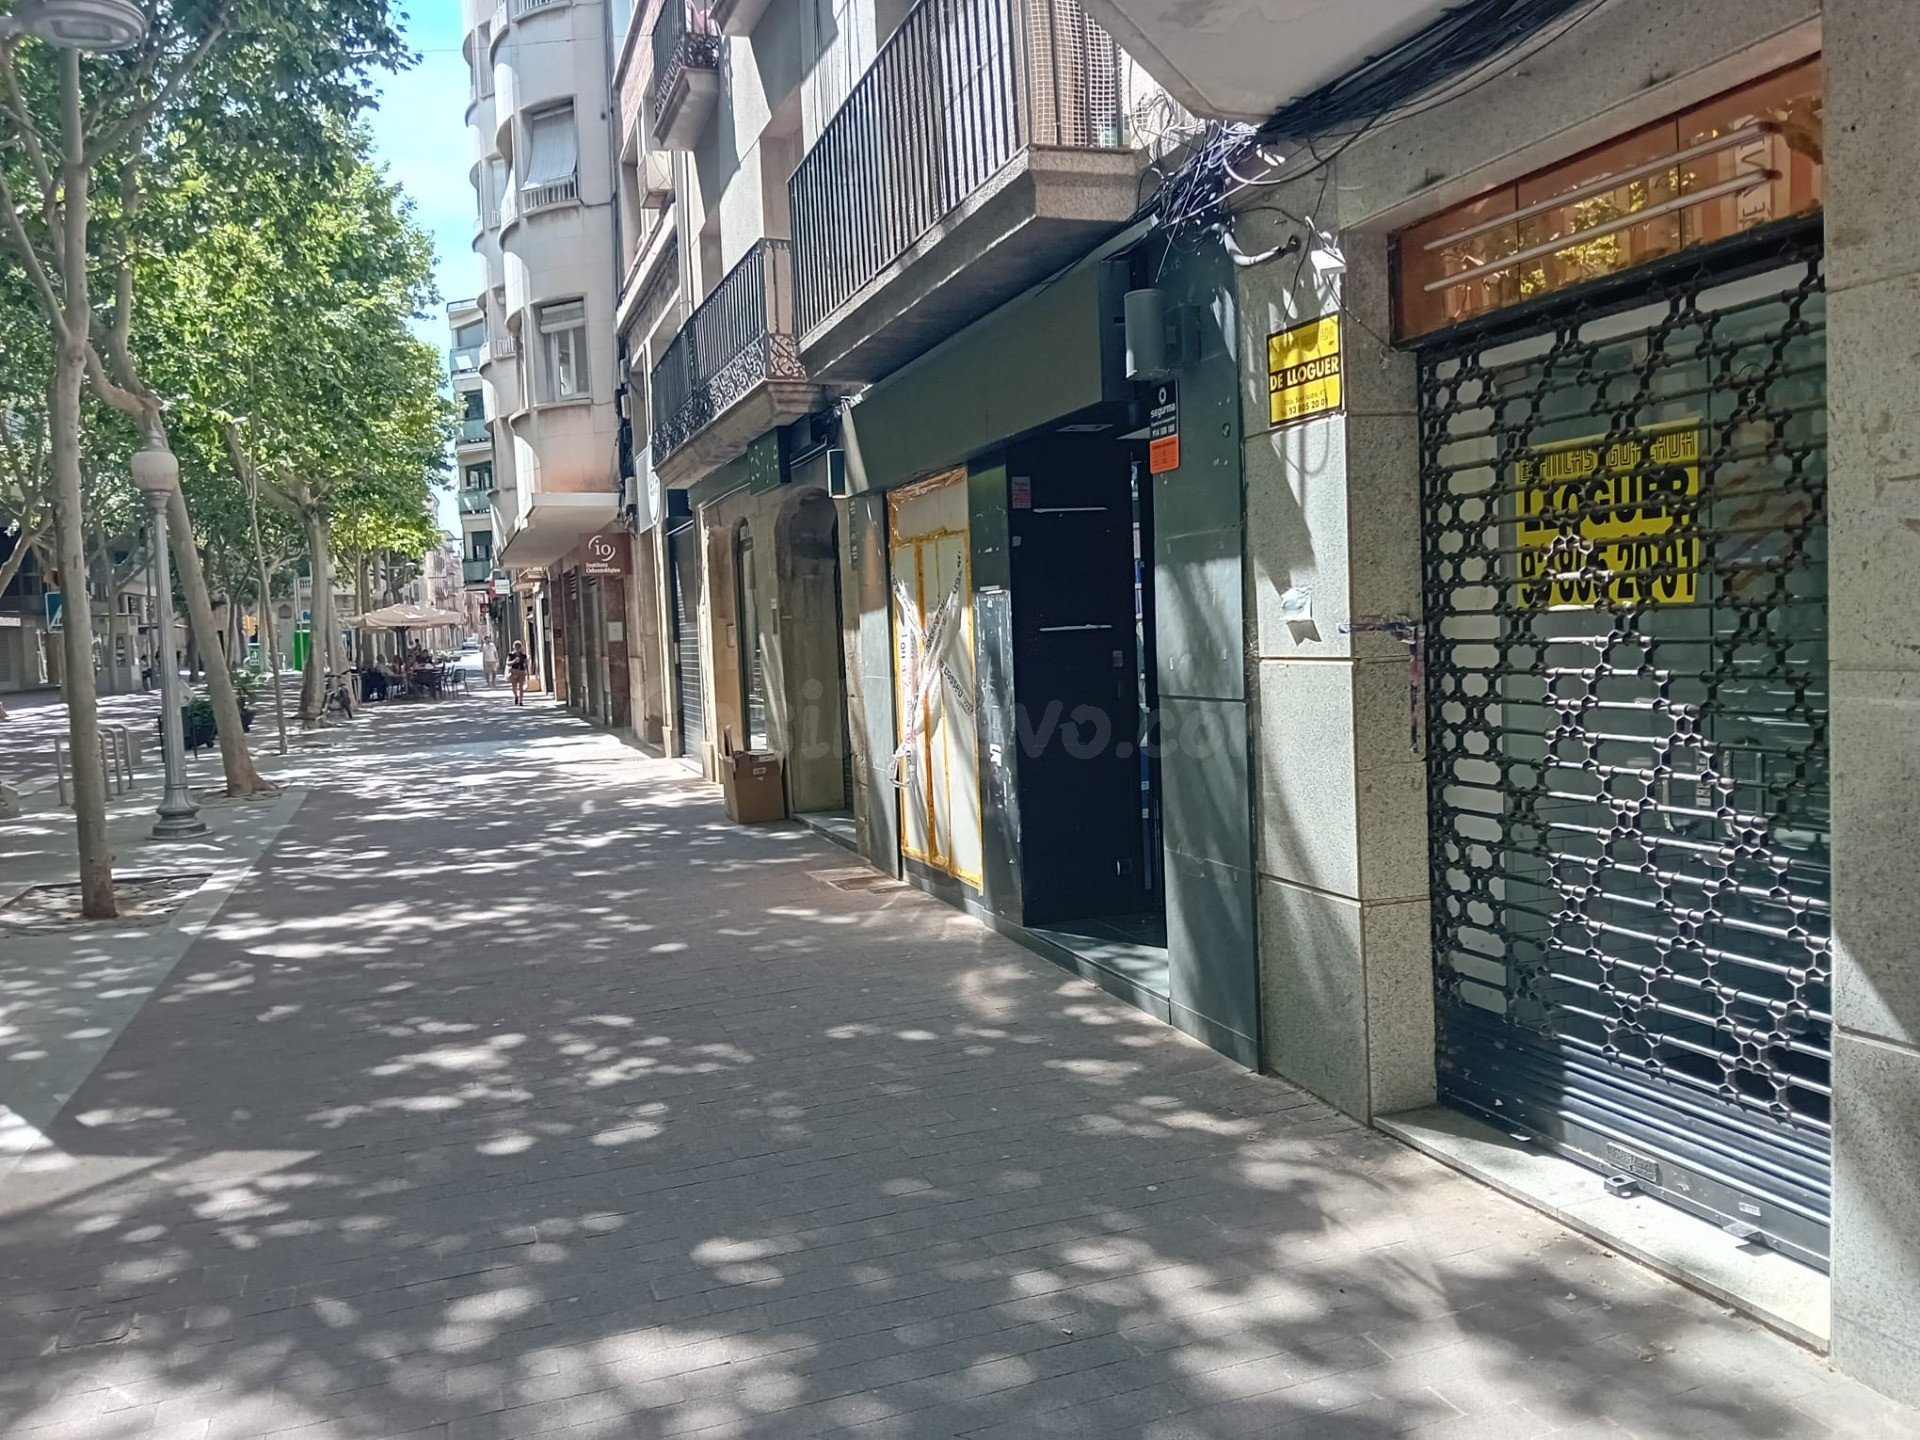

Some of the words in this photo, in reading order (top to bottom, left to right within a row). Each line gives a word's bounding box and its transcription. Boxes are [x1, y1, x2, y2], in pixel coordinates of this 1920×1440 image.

[1270, 373, 1284, 392] DE
[1287, 356, 1339, 386] LLOGUER
[1524, 466, 1690, 532] LLOGUER
[1616, 534, 1652, 599] 20
[1657, 530, 1694, 598] 01
